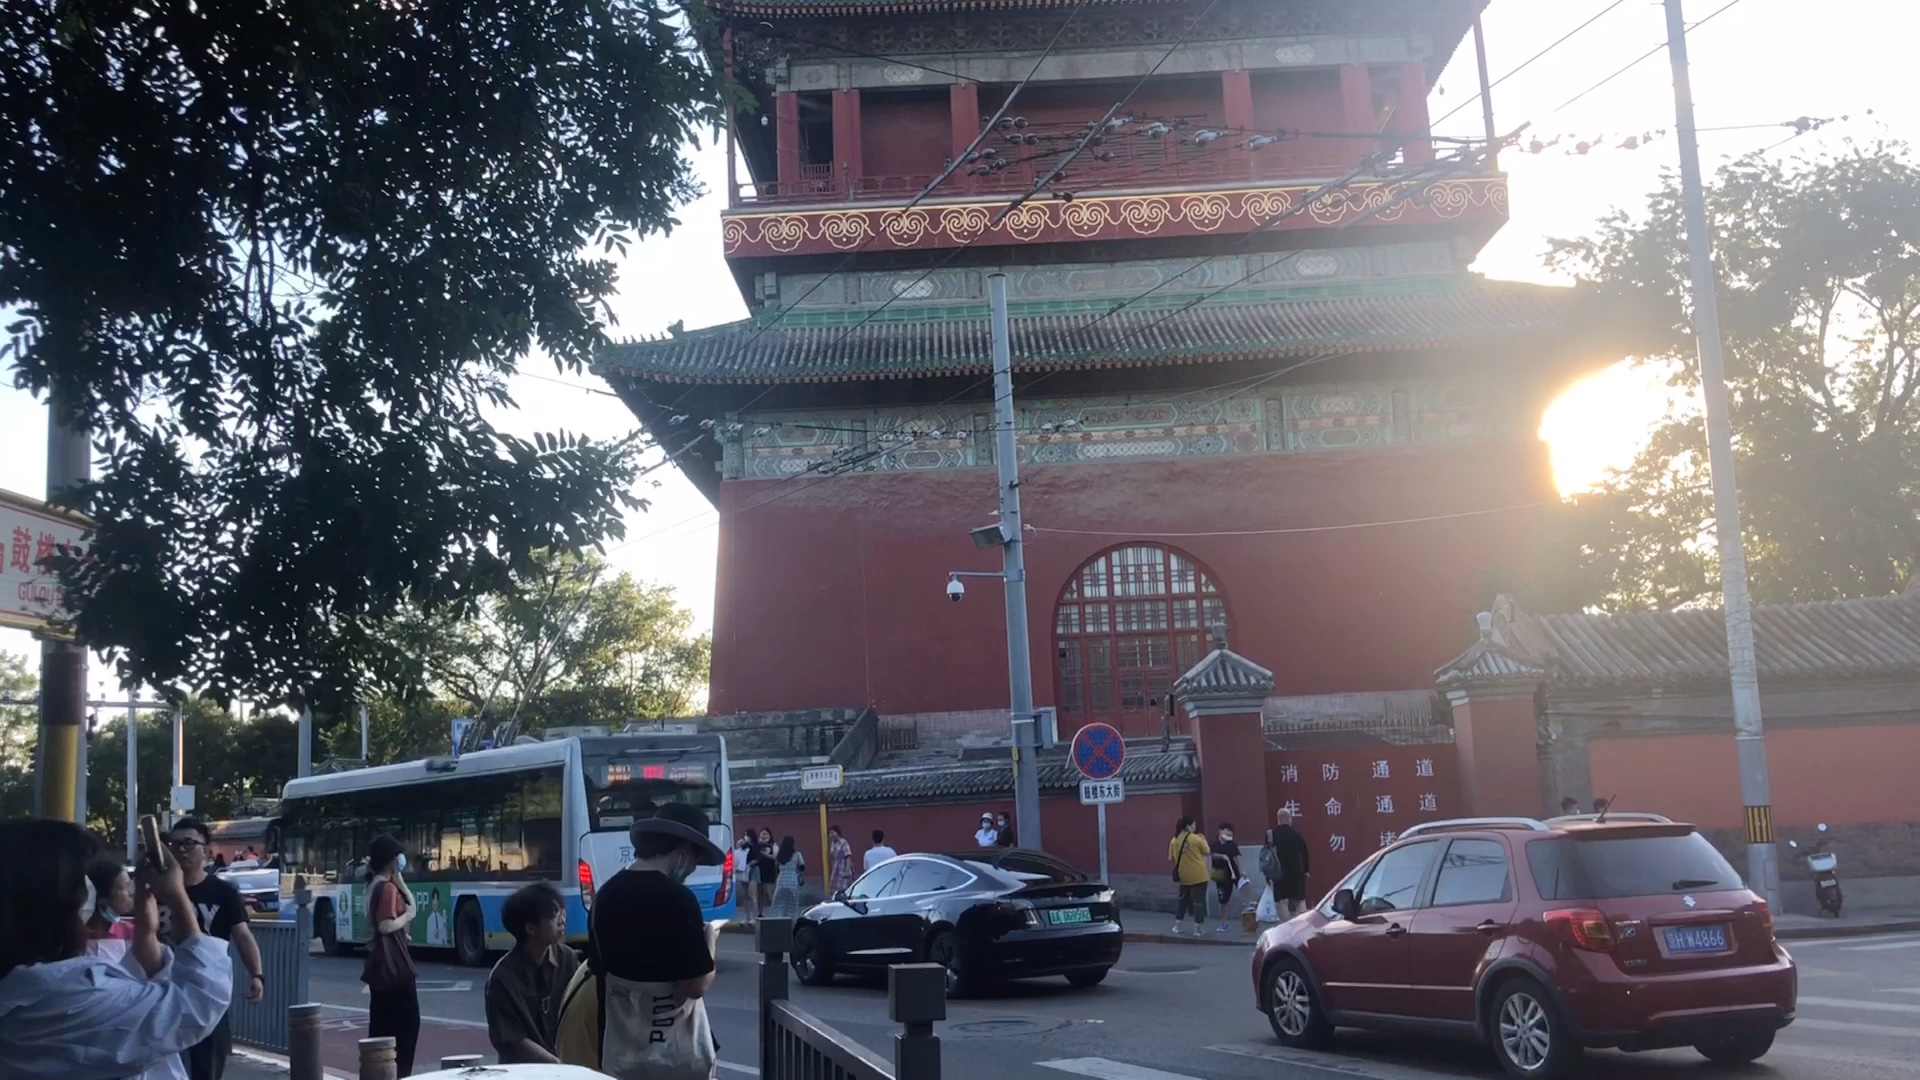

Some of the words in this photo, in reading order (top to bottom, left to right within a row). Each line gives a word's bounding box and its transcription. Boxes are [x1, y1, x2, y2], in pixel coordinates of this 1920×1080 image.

[1281, 758, 1434, 783] 消防通道
[1284, 792, 1437, 817] 生命通道
